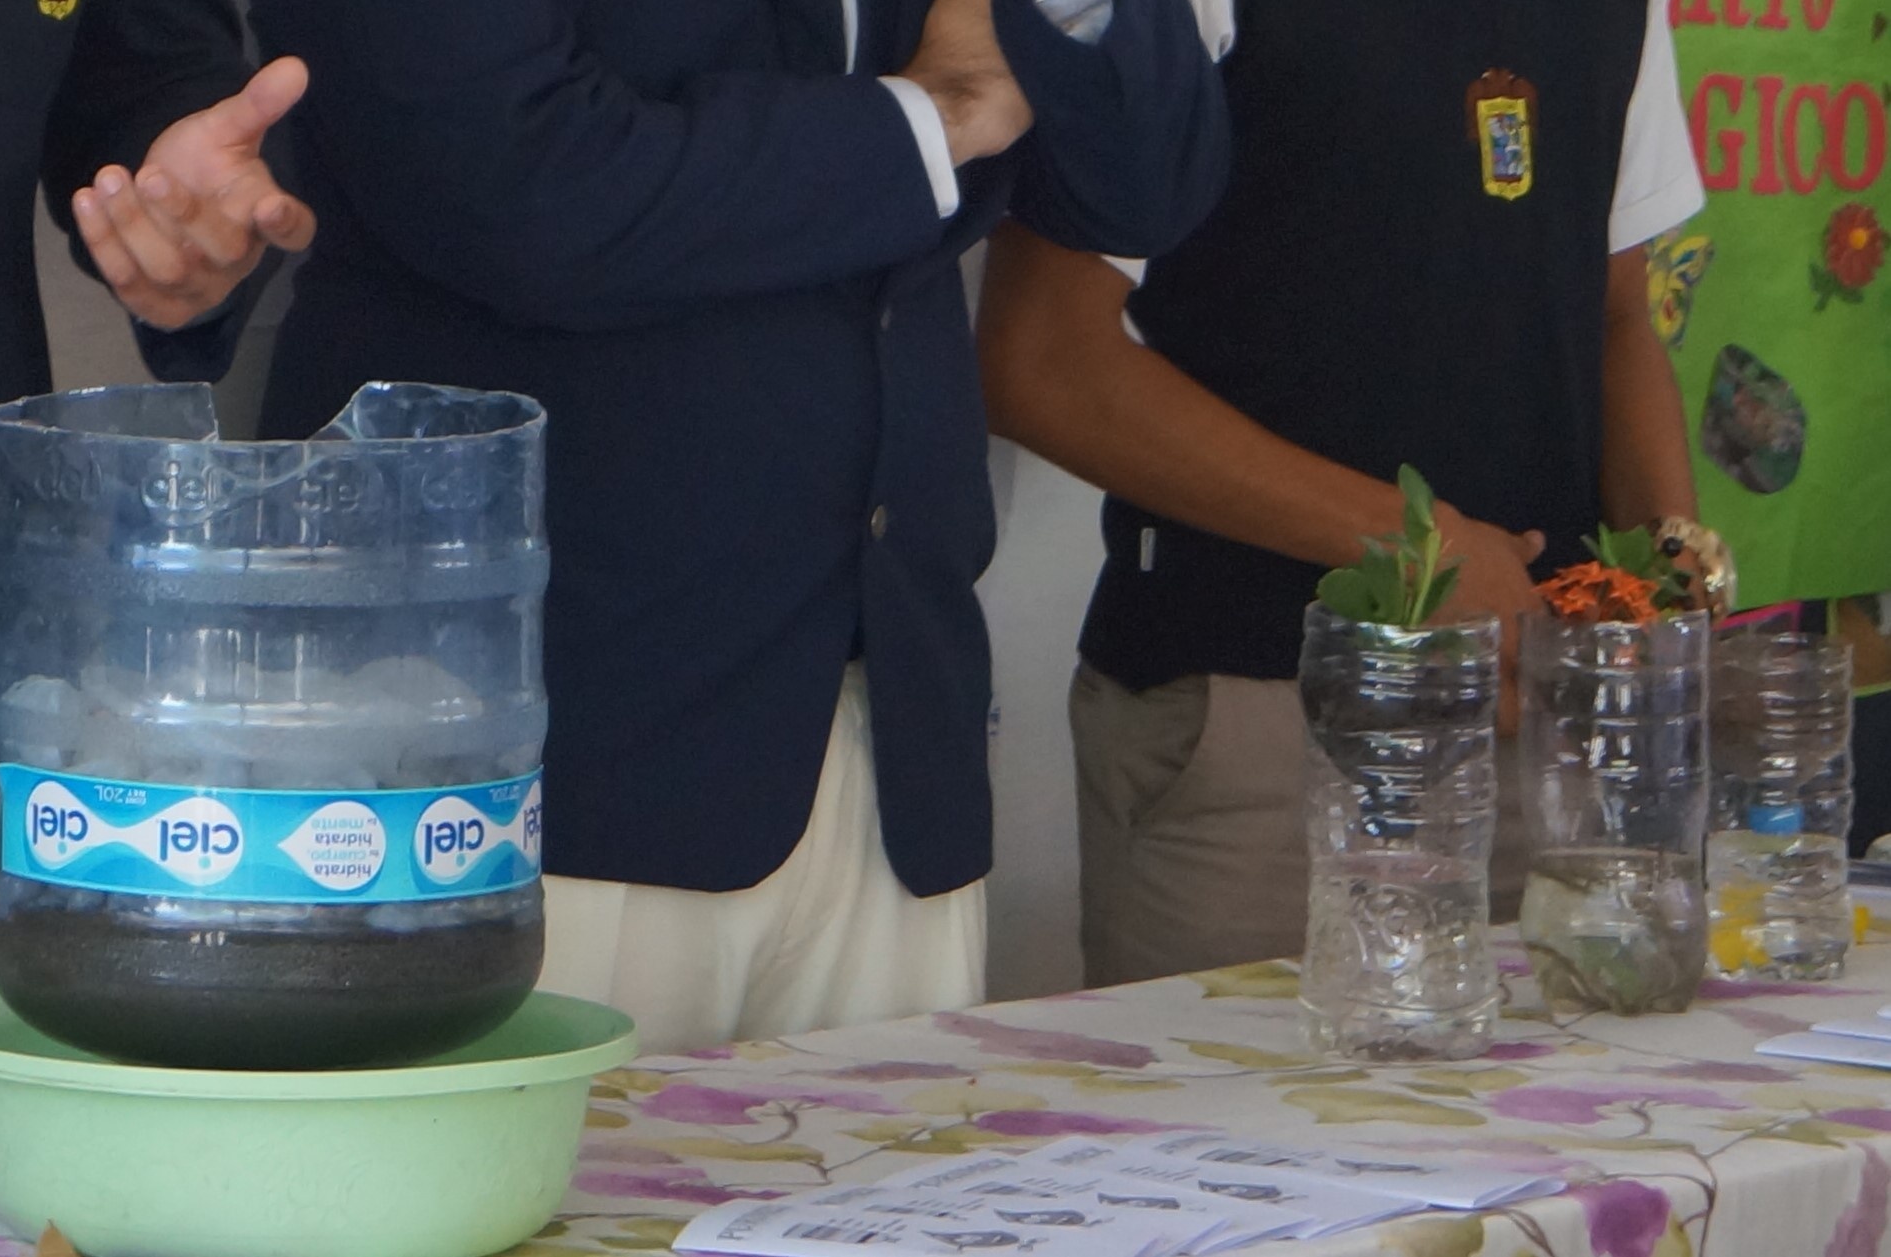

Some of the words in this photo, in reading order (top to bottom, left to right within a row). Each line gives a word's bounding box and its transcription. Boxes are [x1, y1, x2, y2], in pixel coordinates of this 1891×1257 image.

[32, 802, 89, 855] ciel
[159, 819, 240, 870] ciel
[314, 832, 373, 847] hidrata
[424, 818, 485, 867] ciel
[313, 863, 372, 879] hidrata
